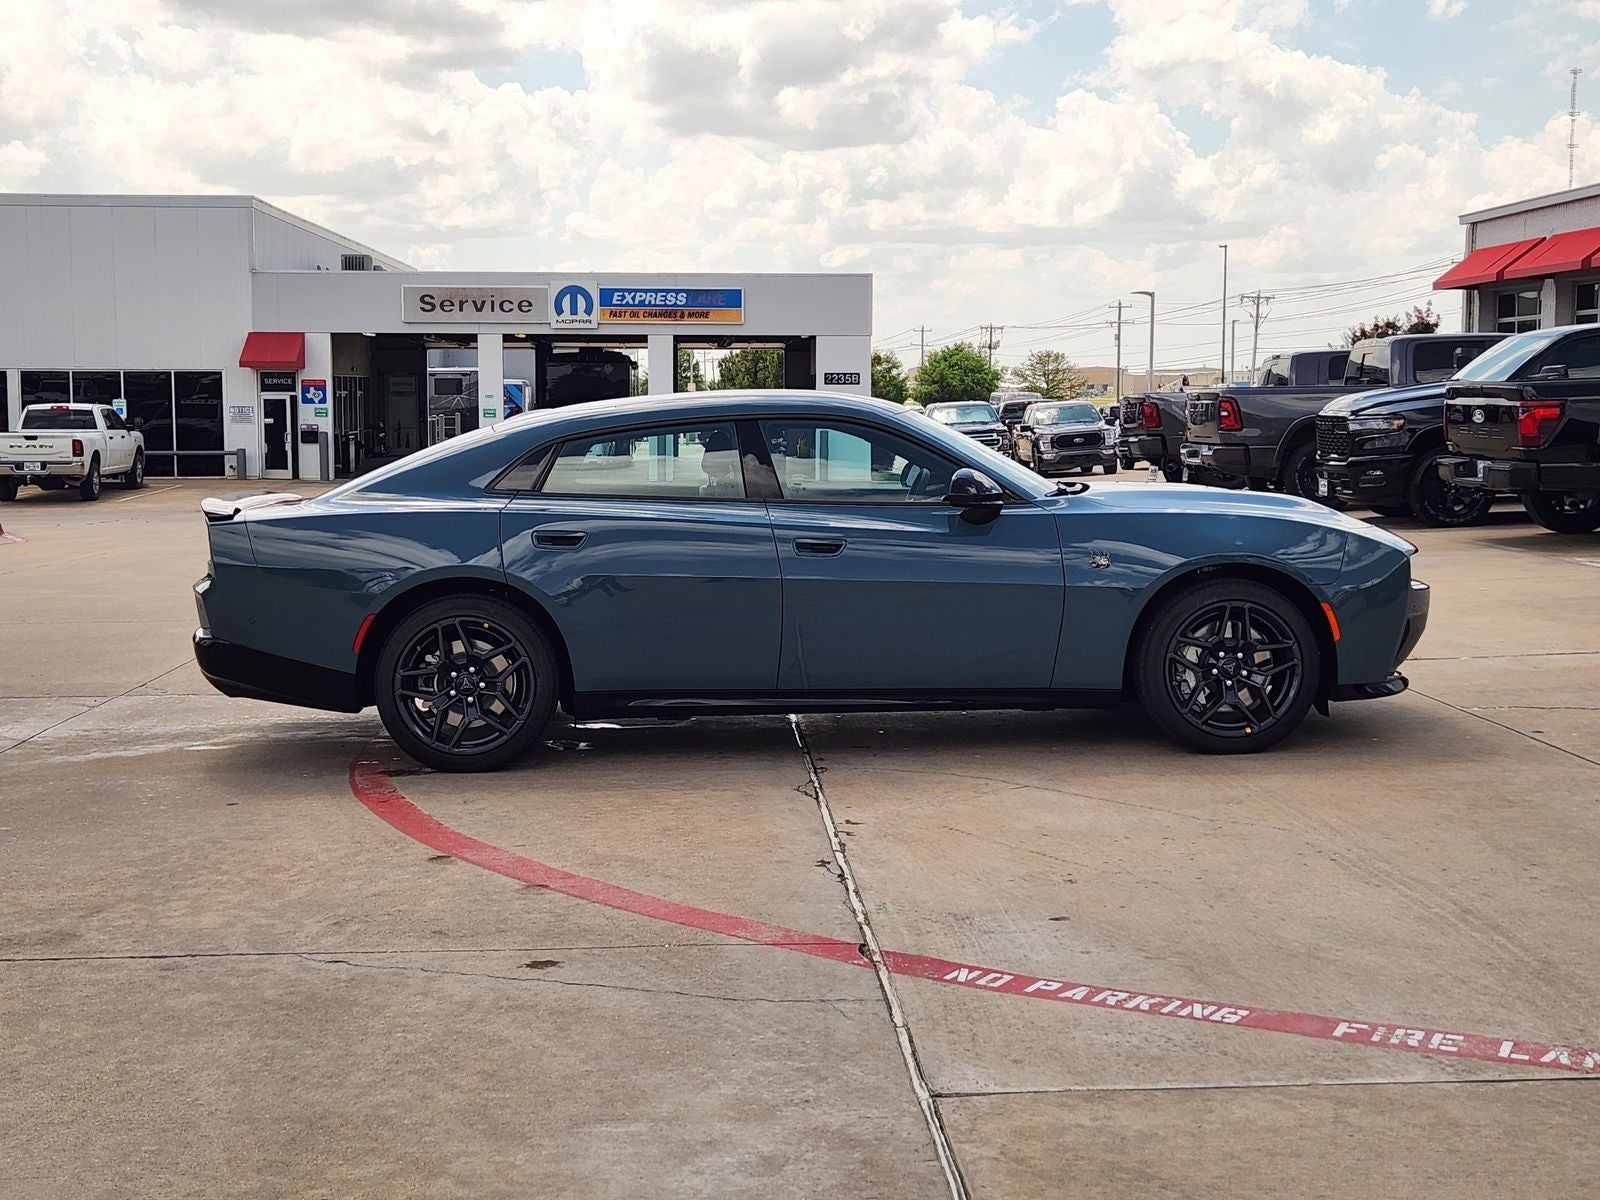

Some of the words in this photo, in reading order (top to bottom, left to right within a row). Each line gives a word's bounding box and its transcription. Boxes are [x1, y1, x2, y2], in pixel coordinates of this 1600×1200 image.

[419, 294, 533, 313] Service
[612, 292, 687, 305] EXPRESS
[608, 311, 627, 319] FAST
[629, 311, 641, 319] OIL
[642, 311, 678, 319] CHANGES
[679, 311, 685, 319] &
[687, 311, 711, 319] MORE
[825, 373, 859, 384] 2235B
[943, 968, 1014, 988] NO
[1023, 979, 1250, 1024] PARKING
[1331, 1022, 1465, 1052] FIRE
